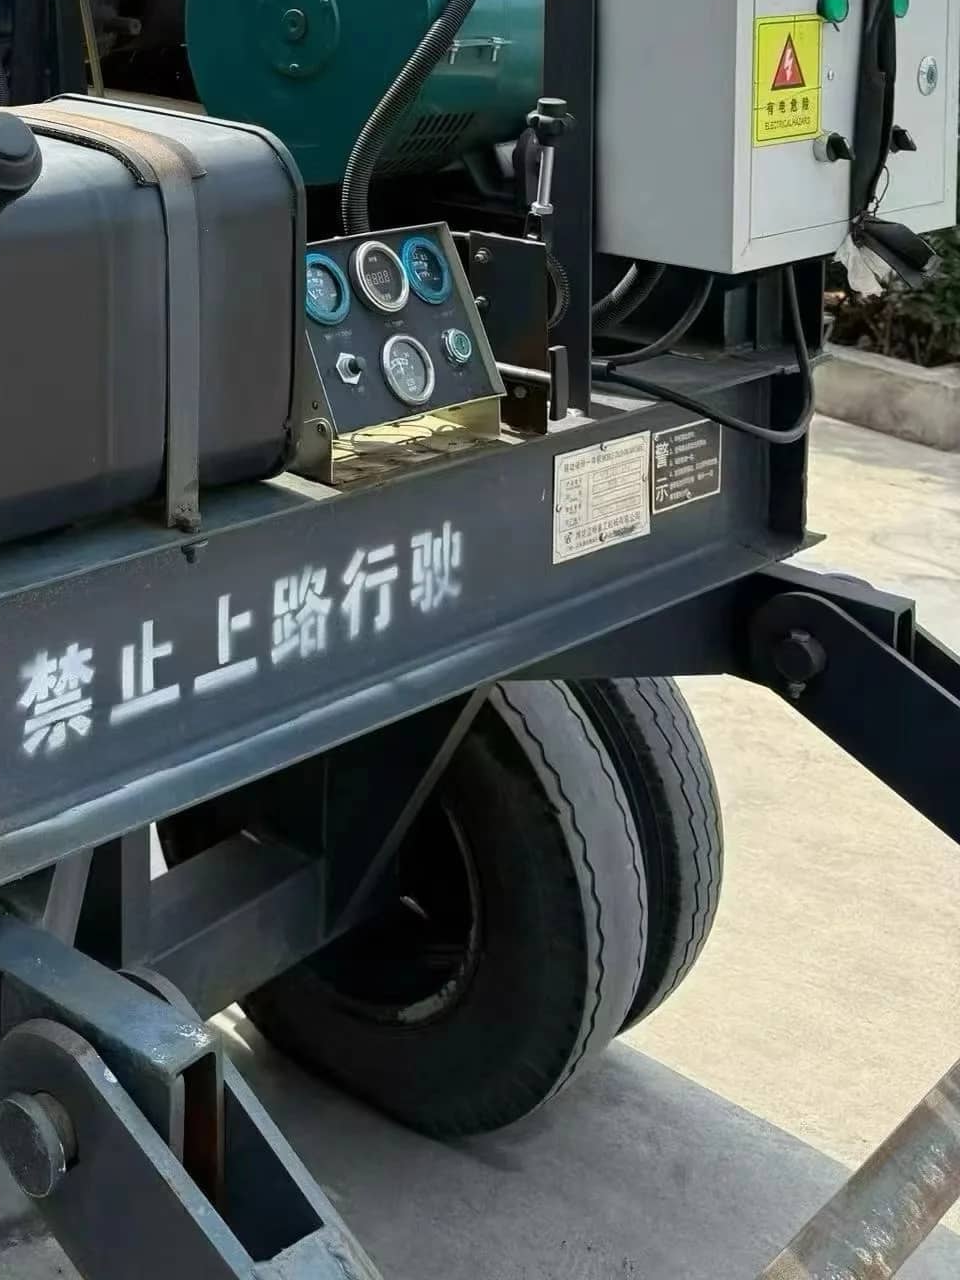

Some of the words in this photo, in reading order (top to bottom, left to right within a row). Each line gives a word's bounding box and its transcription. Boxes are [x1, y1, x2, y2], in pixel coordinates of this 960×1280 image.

[766, 95, 810, 116] 有电危险
[655, 440, 670, 502] 警示
[18, 521, 463, 755] 禁止上路行驶
